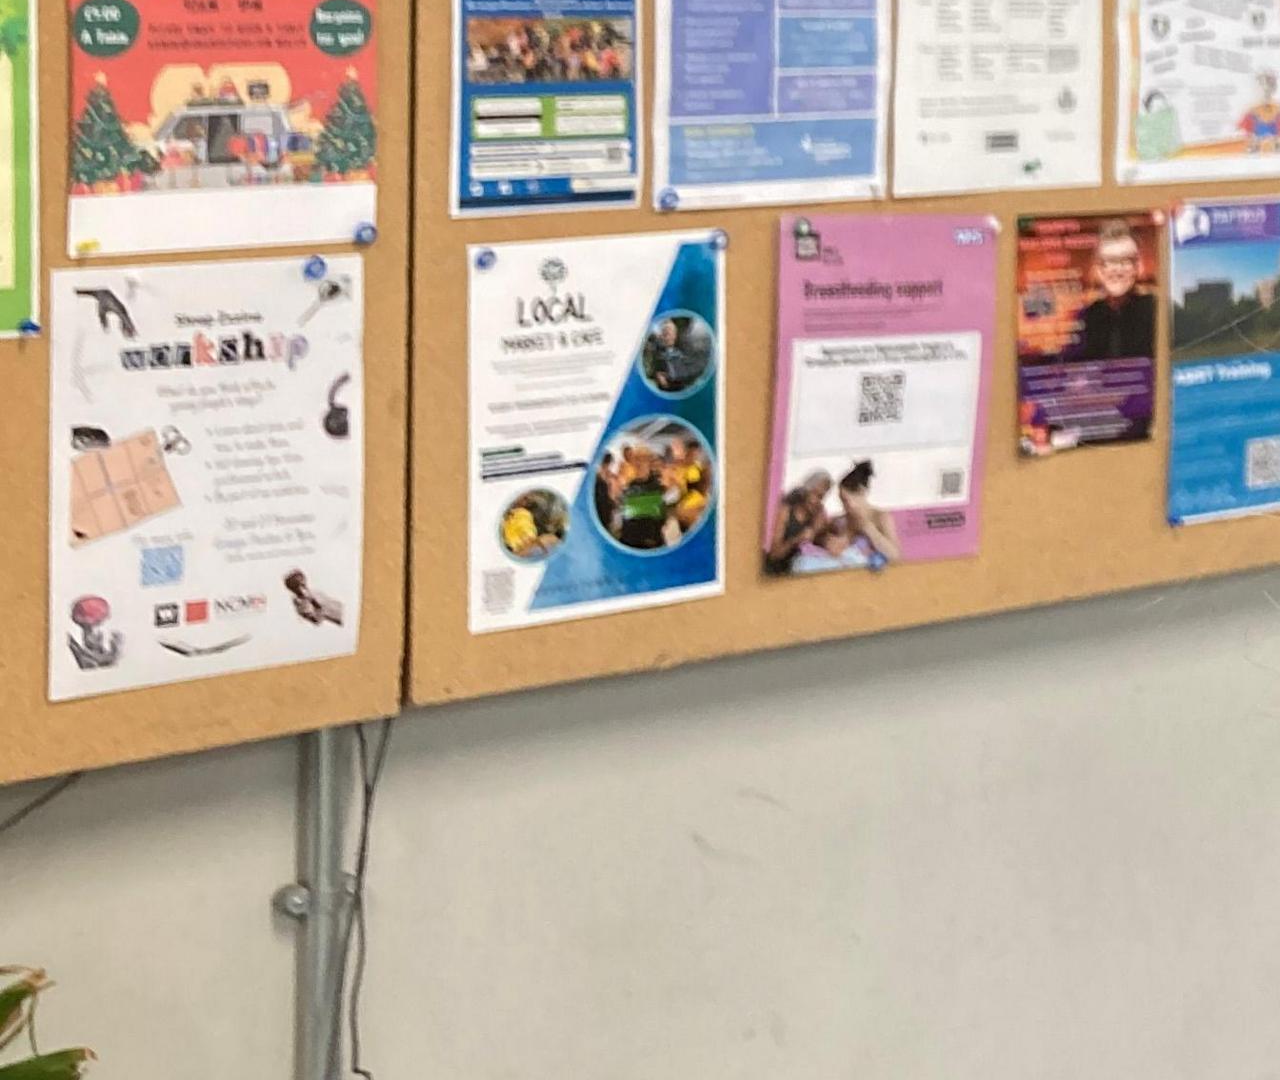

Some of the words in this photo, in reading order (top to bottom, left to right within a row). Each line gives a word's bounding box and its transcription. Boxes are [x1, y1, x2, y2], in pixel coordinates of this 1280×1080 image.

[803, 278, 893, 302] Breastfeeding
[896, 278, 944, 302] support
[516, 291, 595, 328] LOCAL
